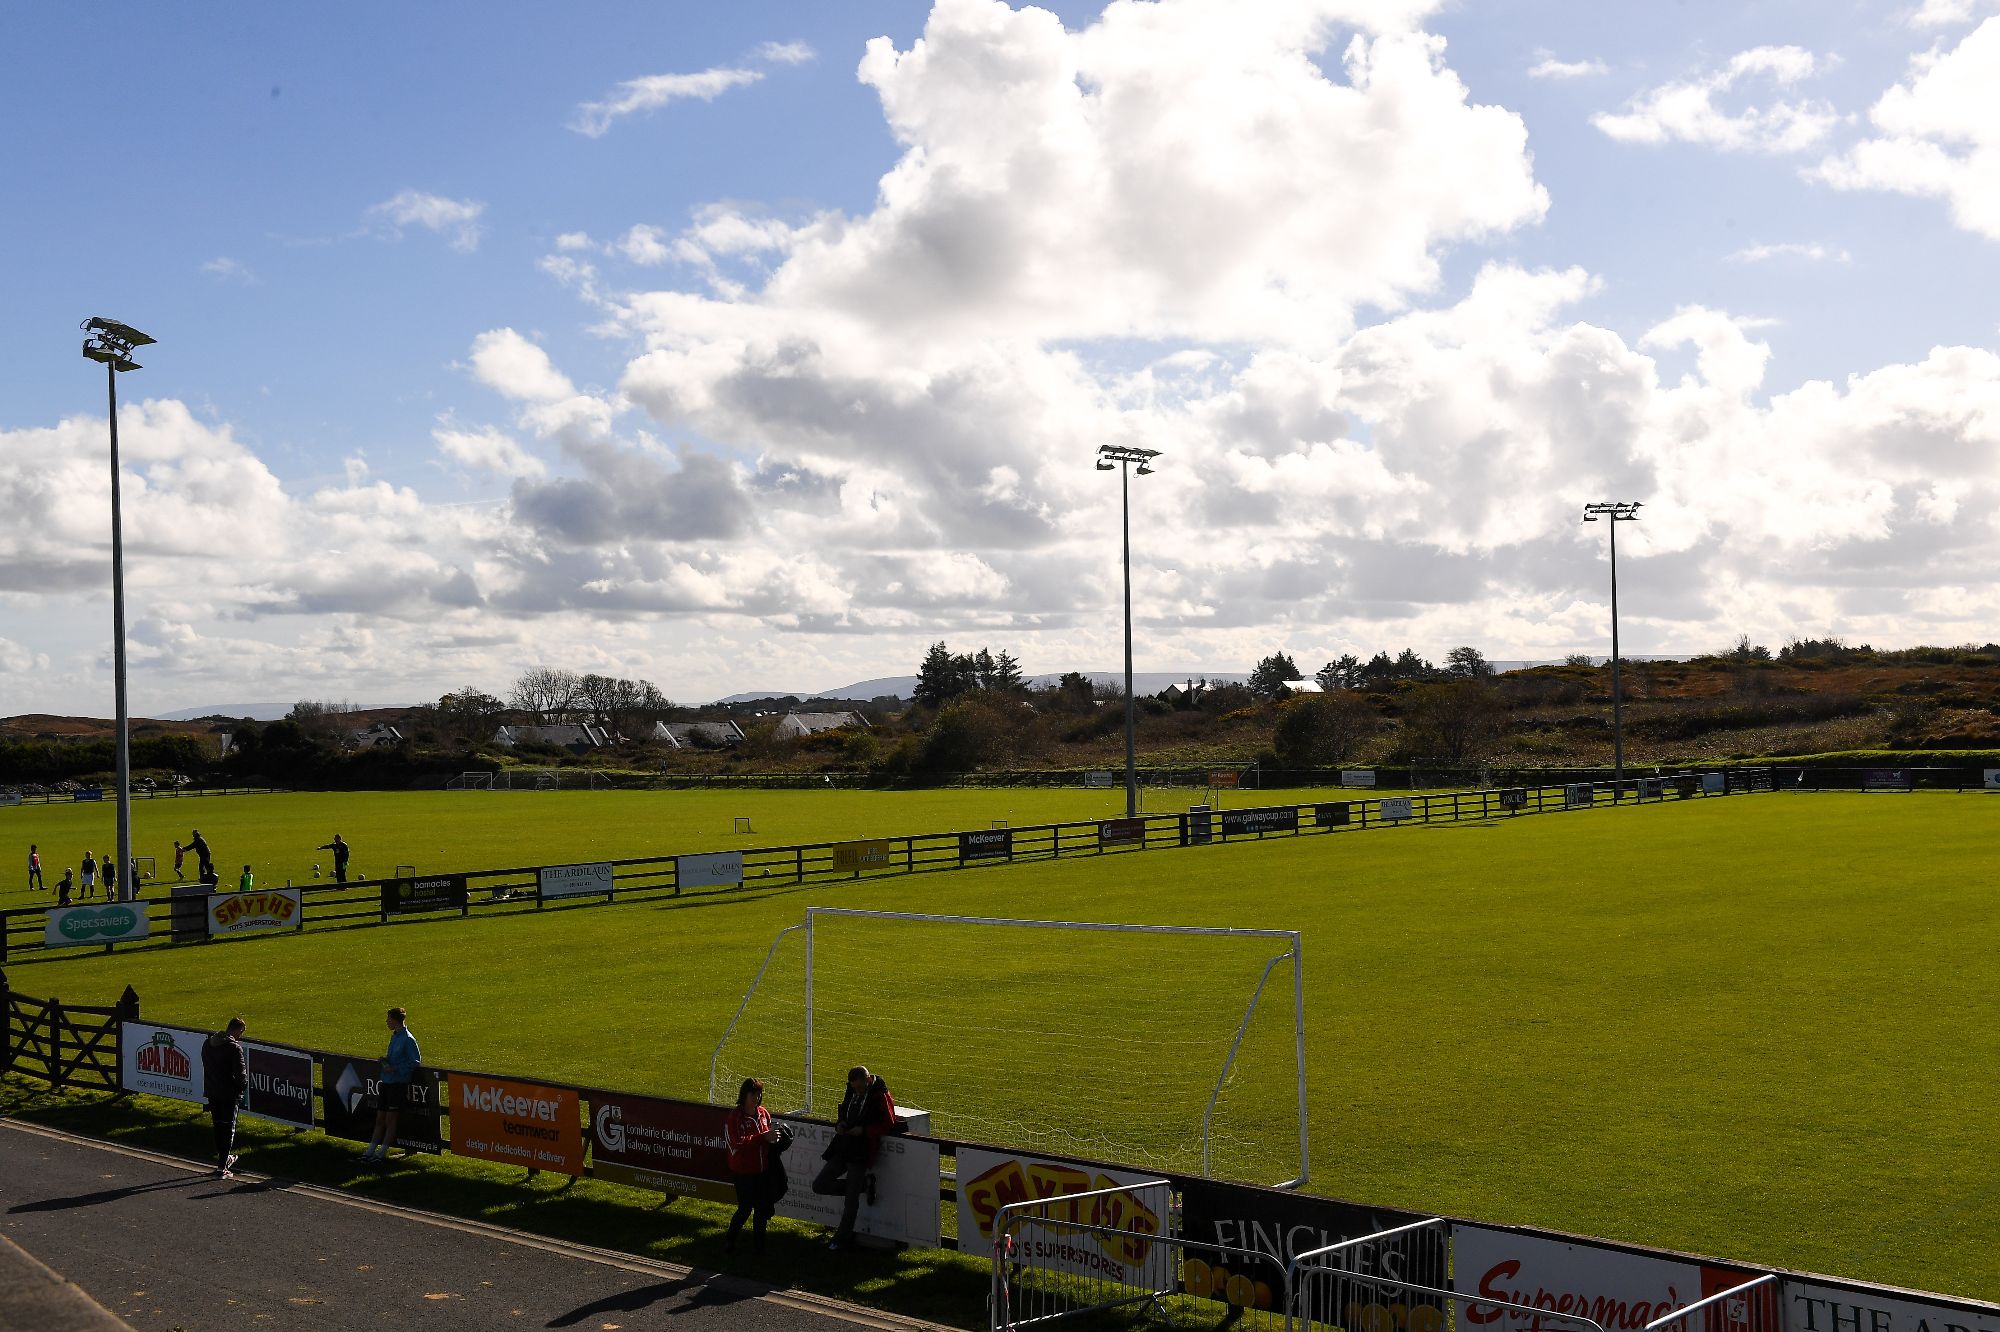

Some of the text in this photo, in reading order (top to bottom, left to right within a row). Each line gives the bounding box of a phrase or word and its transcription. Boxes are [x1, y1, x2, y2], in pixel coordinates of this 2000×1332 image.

[968, 834, 1005, 844] McKeever
[66, 916, 130, 932] Specsavers
[215, 896, 295, 924] SMYTHS
[137, 1045, 161, 1073] PAPA
[250, 1072, 309, 1106] NUI Galway
[463, 1083, 558, 1121] McKeever
[502, 1119, 560, 1142] teamwear
[626, 1124, 660, 1139] Comhairle
[661, 1129, 691, 1144] Cathrach
[693, 1136, 702, 1145] na
[790, 1124, 816, 1140] TAX
[465, 1138, 488, 1152] design
[495, 1143, 531, 1158] dedication
[538, 1149, 566, 1166] delivery
[627, 1139, 692, 1160] Galway City Council
[971, 1171, 1154, 1260] SMYTHS
[1035, 1241, 1124, 1281] SUPERSTORES
[1213, 1219, 1406, 1297] FINCHES
